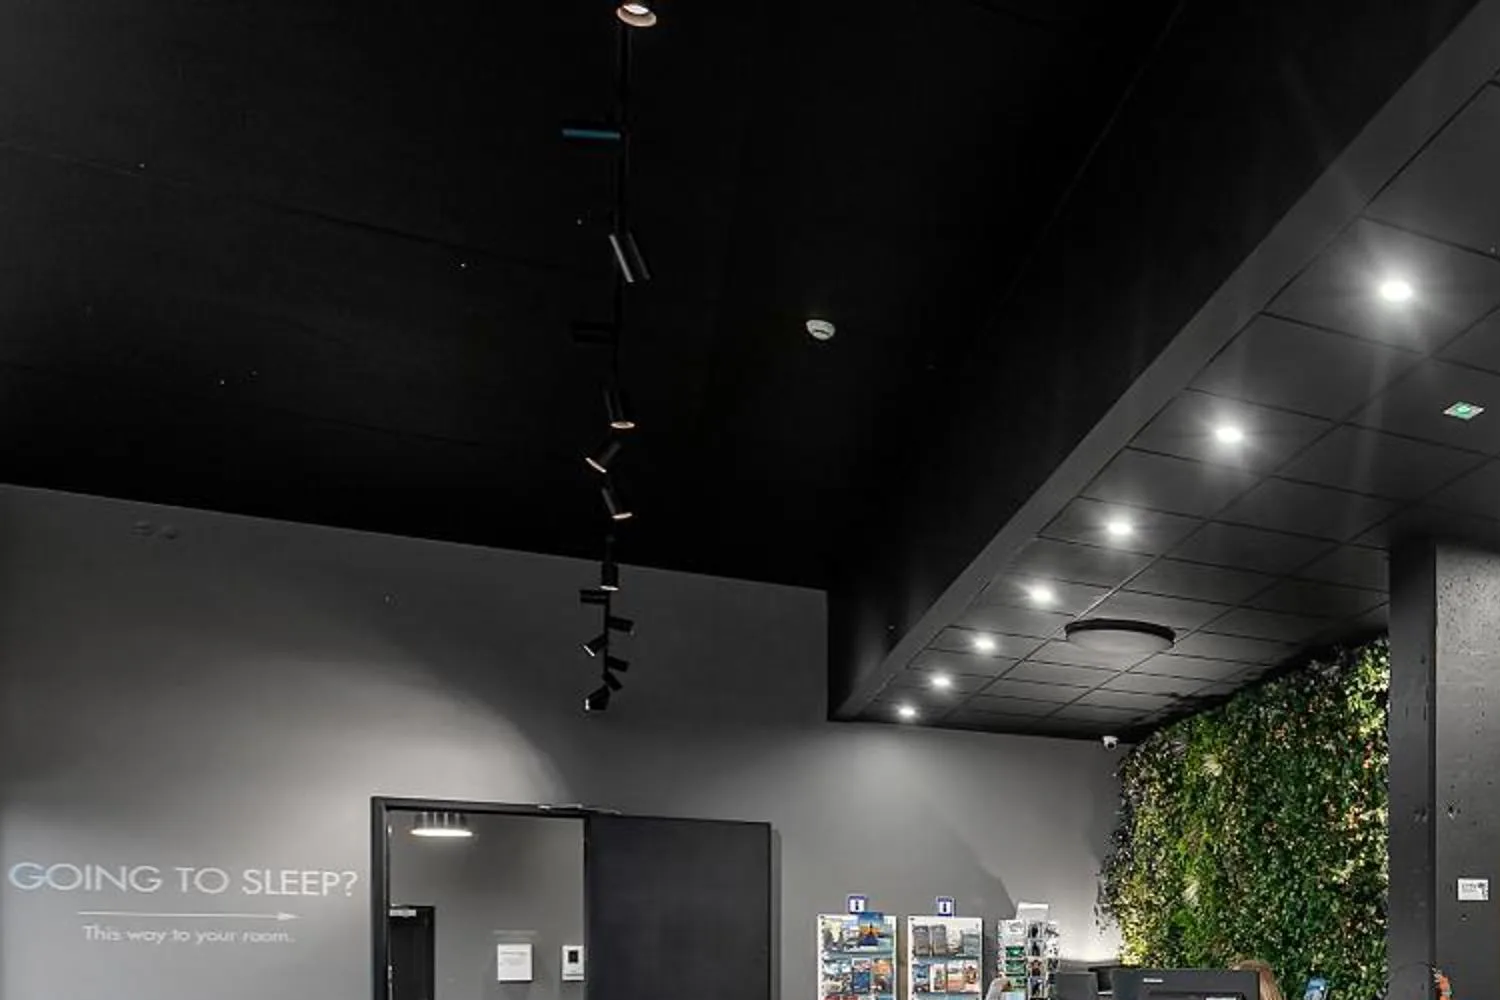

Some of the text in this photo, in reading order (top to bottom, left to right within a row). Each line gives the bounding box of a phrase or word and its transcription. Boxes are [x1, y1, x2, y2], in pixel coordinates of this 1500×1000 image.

[8, 862, 358, 896] GOING TO SLEEP?
[83, 925, 121, 941] This
[126, 928, 166, 945] way
[173, 928, 191, 942] to
[195, 930, 235, 945] your
